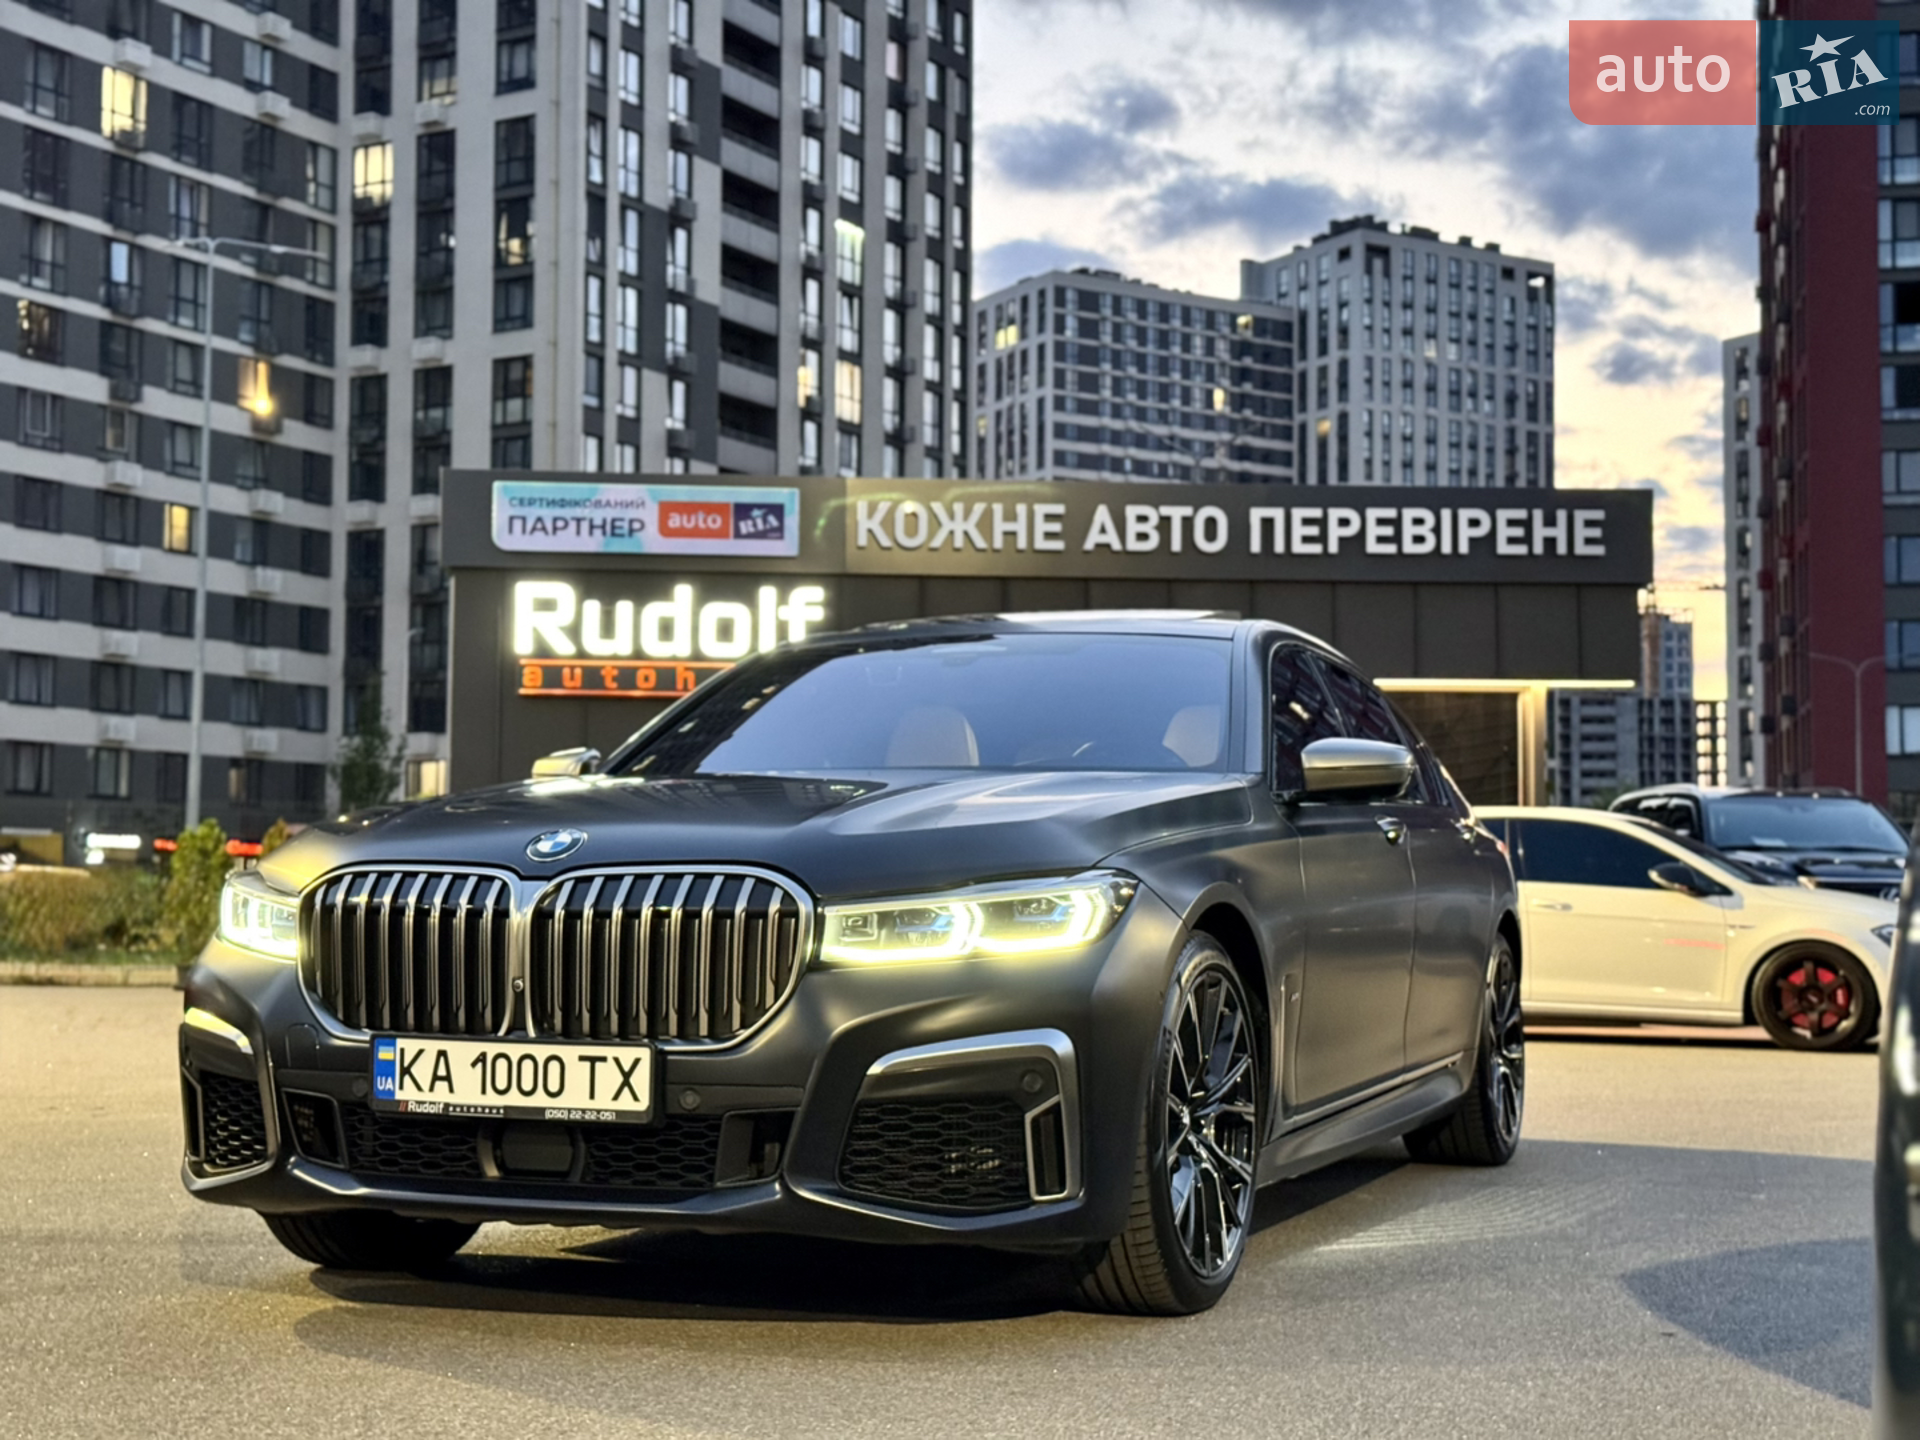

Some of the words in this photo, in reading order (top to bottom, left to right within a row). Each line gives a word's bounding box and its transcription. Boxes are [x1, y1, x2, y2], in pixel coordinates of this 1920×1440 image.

[508, 495, 646, 509] СЕРТИФІКОВАНИЙ
[508, 515, 646, 539] ПАРТНЕР
[667, 510, 722, 530] auto
[855, 501, 1066, 552] КОЖНЕ
[1084, 505, 1228, 554] АВТО
[1250, 506, 1606, 556] ПЕРЕВІРЕНЕ
[513, 580, 825, 658] Rudolf
[376, 1076, 394, 1092] UA
[398, 1047, 455, 1094] KA
[470, 1051, 565, 1099] 1000
[578, 1055, 642, 1103] TX
[407, 1100, 444, 1114] Rudolf
